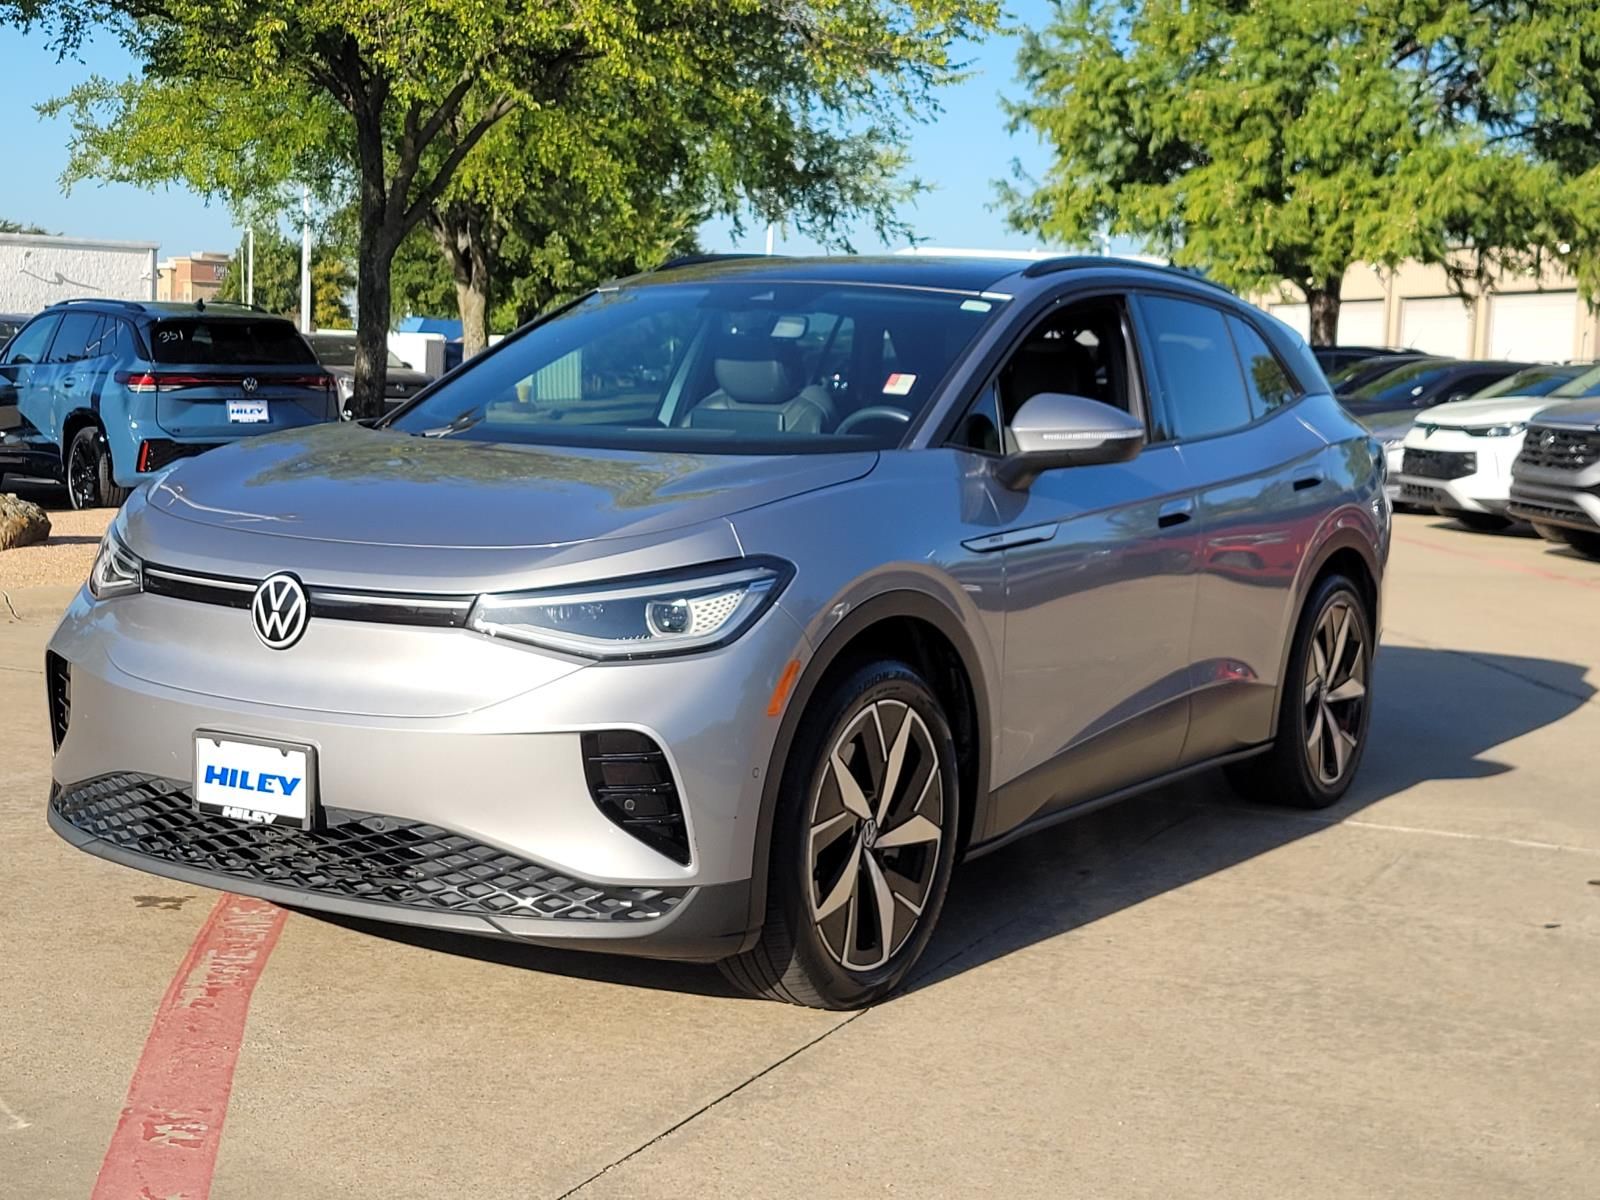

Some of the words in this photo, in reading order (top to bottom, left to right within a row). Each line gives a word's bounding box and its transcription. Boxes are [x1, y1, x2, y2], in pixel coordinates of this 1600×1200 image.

[159, 330, 183, 343] 351
[204, 765, 301, 796] HILEY
[222, 805, 278, 824] HILEY
